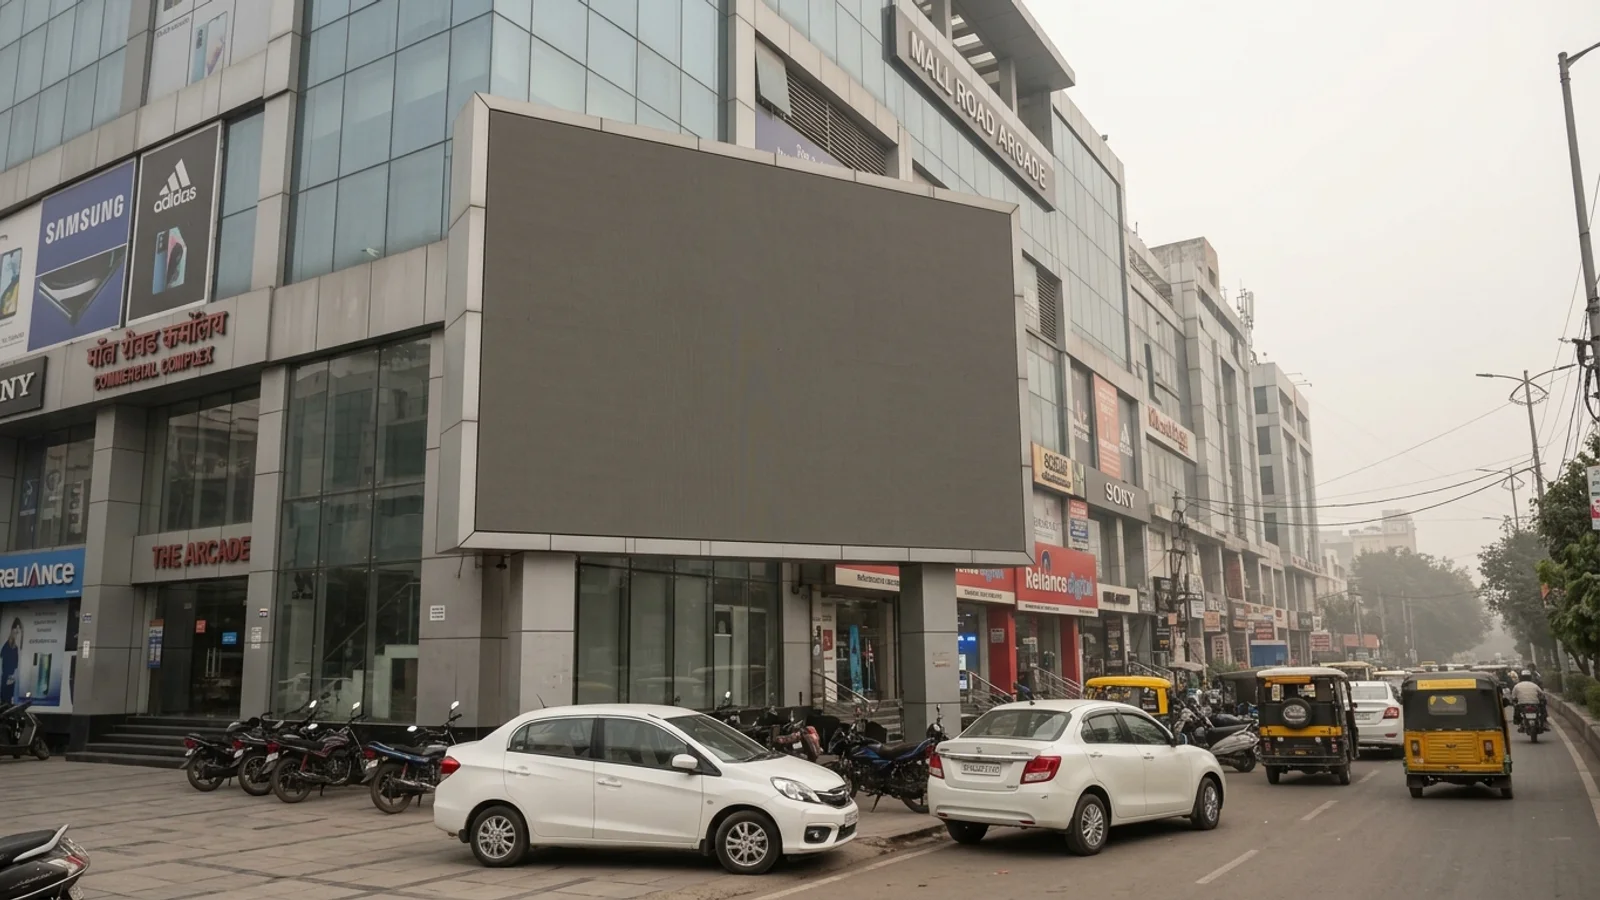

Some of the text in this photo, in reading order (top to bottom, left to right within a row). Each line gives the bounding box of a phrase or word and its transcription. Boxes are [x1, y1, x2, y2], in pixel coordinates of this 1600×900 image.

[910, 31, 953, 96] MALL
[956, 78, 995, 136] ROAD
[45, 194, 124, 244] SAMSUNG
[153, 186, 197, 213] adidas
[152, 536, 252, 570] THE ARCADE
